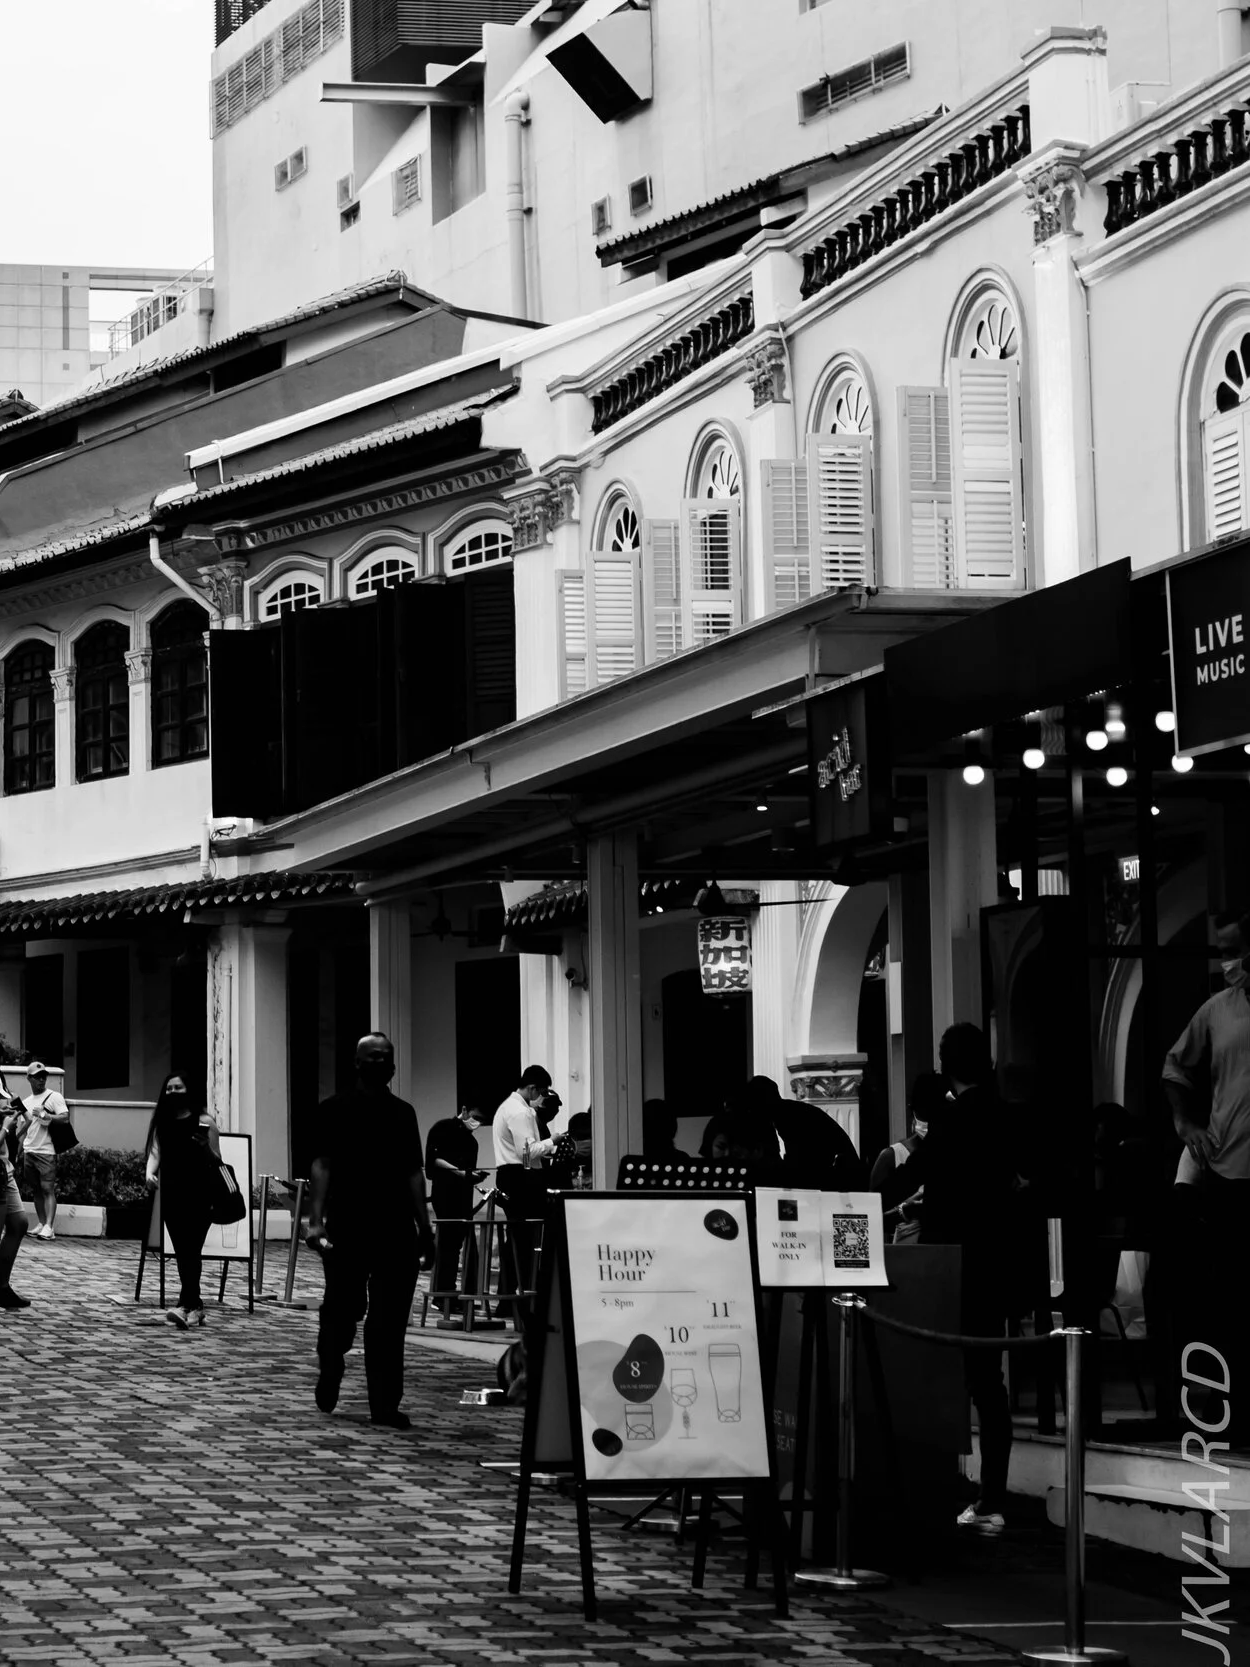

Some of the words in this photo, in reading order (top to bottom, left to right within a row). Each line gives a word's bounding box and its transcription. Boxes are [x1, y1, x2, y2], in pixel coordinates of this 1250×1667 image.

[1195, 614, 1244, 655] LIVE
[1196, 653, 1246, 686] MUSIC
[699, 917, 750, 990] 新加坡
[780, 1231, 797, 1239] FOR
[771, 1241, 807, 1249] WALK-IN
[597, 1244, 656, 1268] Happy
[778, 1253, 801, 1261] ONLY
[598, 1264, 646, 1282] Hour
[601, 1297, 607, 1308] 5
[614, 1297, 635, 1311] 8pm
